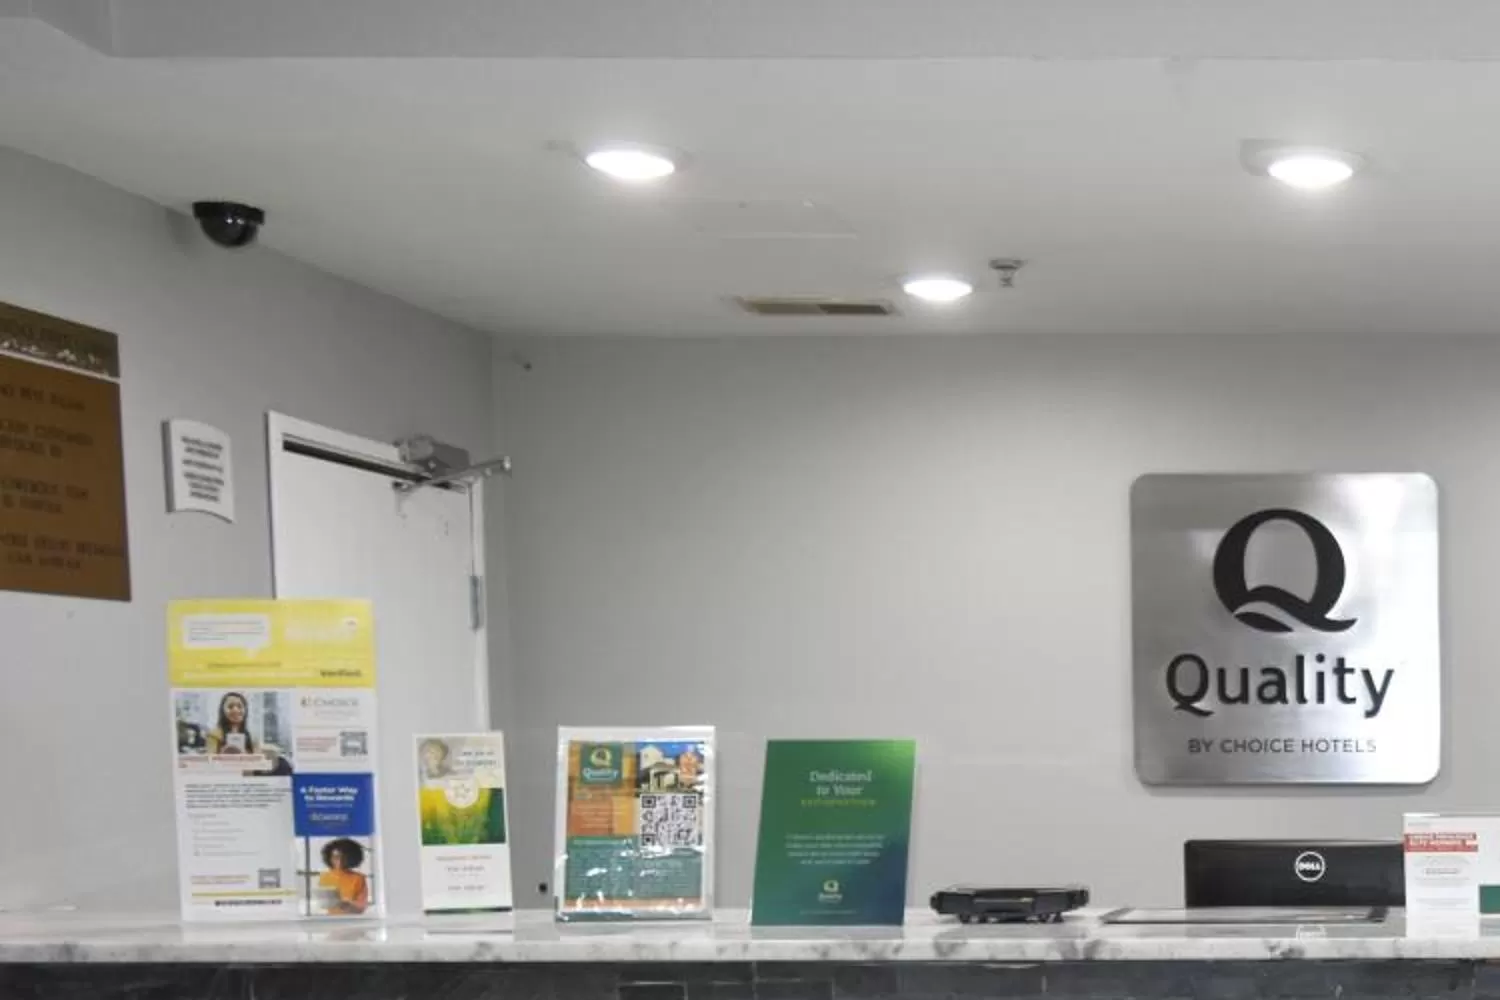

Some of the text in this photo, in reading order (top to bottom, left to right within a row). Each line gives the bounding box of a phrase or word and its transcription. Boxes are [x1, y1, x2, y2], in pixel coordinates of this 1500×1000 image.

[1213, 507, 1358, 633] Q
[1166, 653, 1395, 718] Quality
[1188, 738, 1377, 753] BY CHOICE HOTELS
[809, 769, 873, 782] Dedicated
[816, 783, 865, 796] to Your
